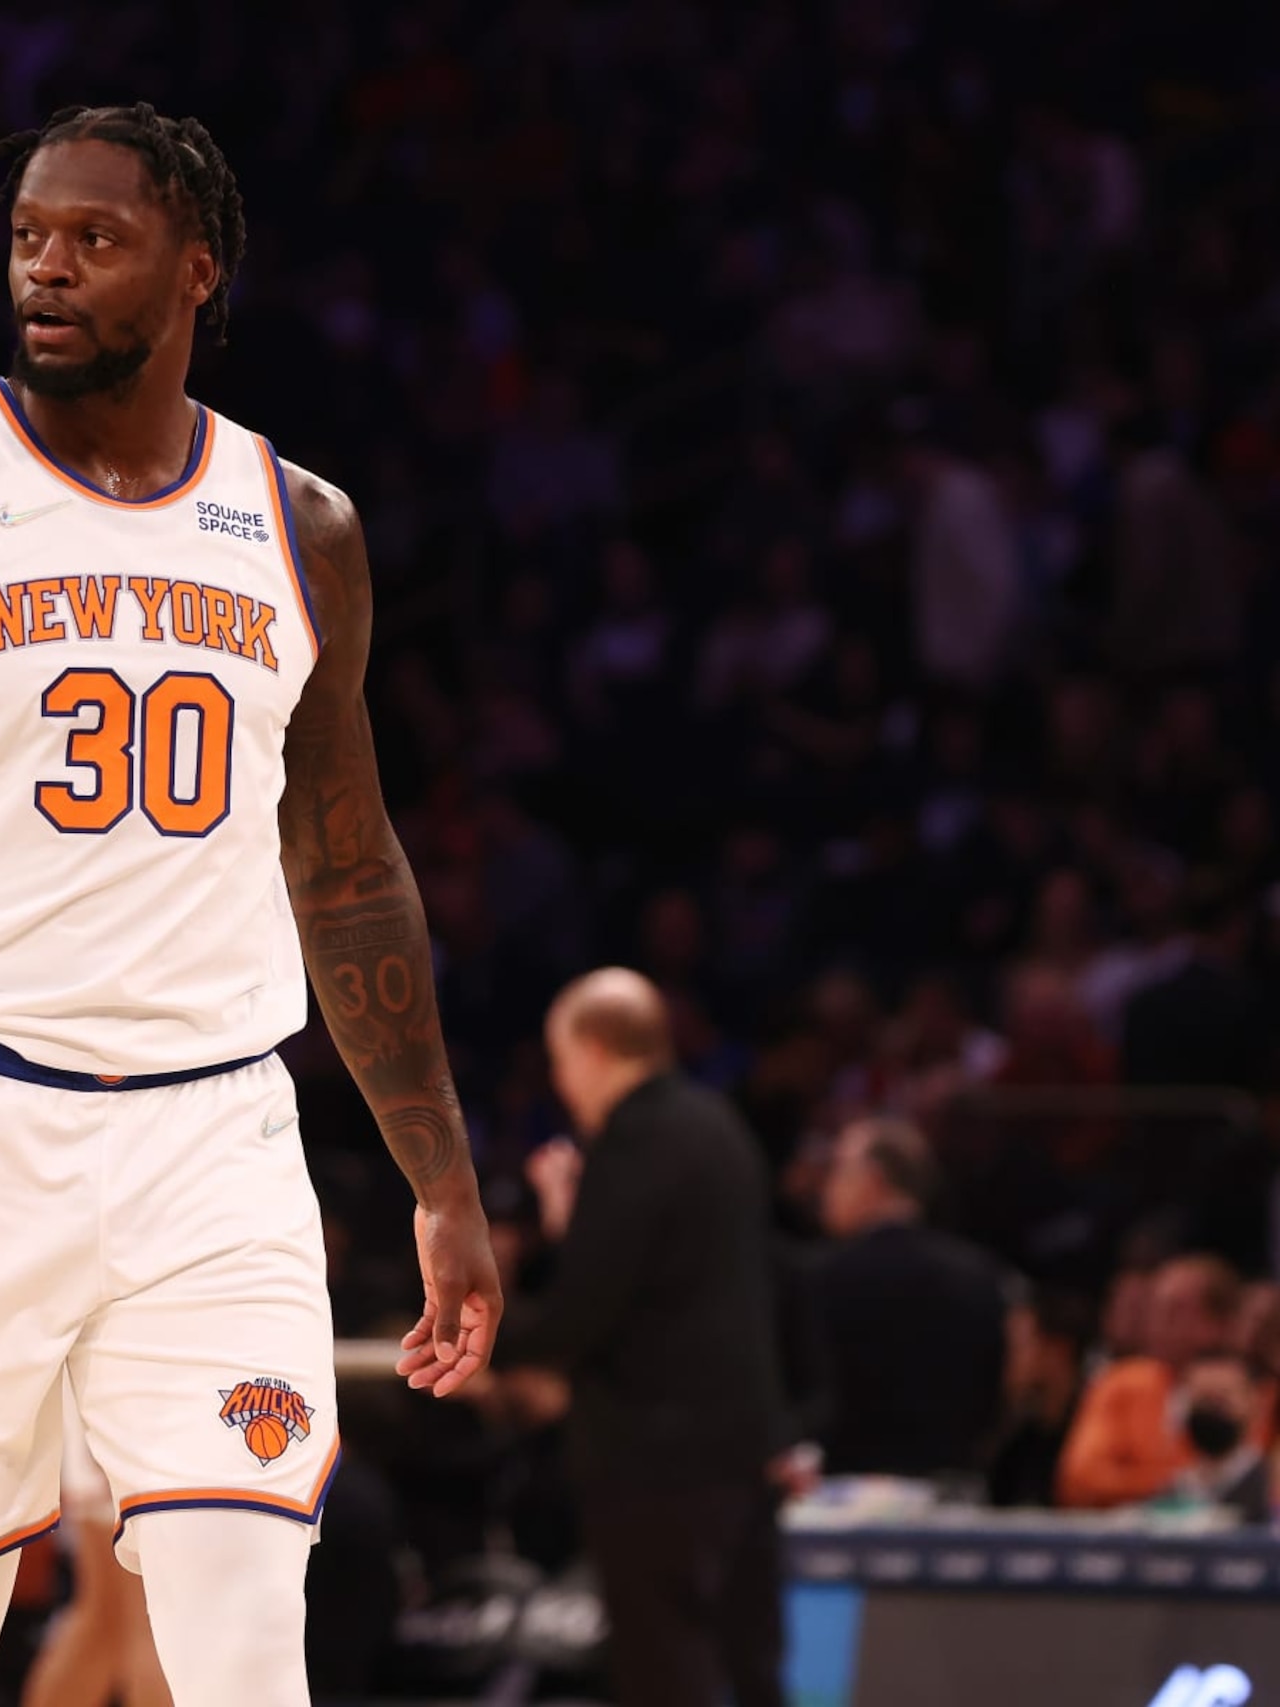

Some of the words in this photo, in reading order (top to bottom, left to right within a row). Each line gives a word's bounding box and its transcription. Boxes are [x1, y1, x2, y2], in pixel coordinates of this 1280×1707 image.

[196, 501, 265, 528] SQUARE
[198, 517, 253, 541] SPACE
[128, 576, 280, 673] YORK
[34, 667, 235, 838] 30
[219, 1381, 311, 1440] KNICKS
